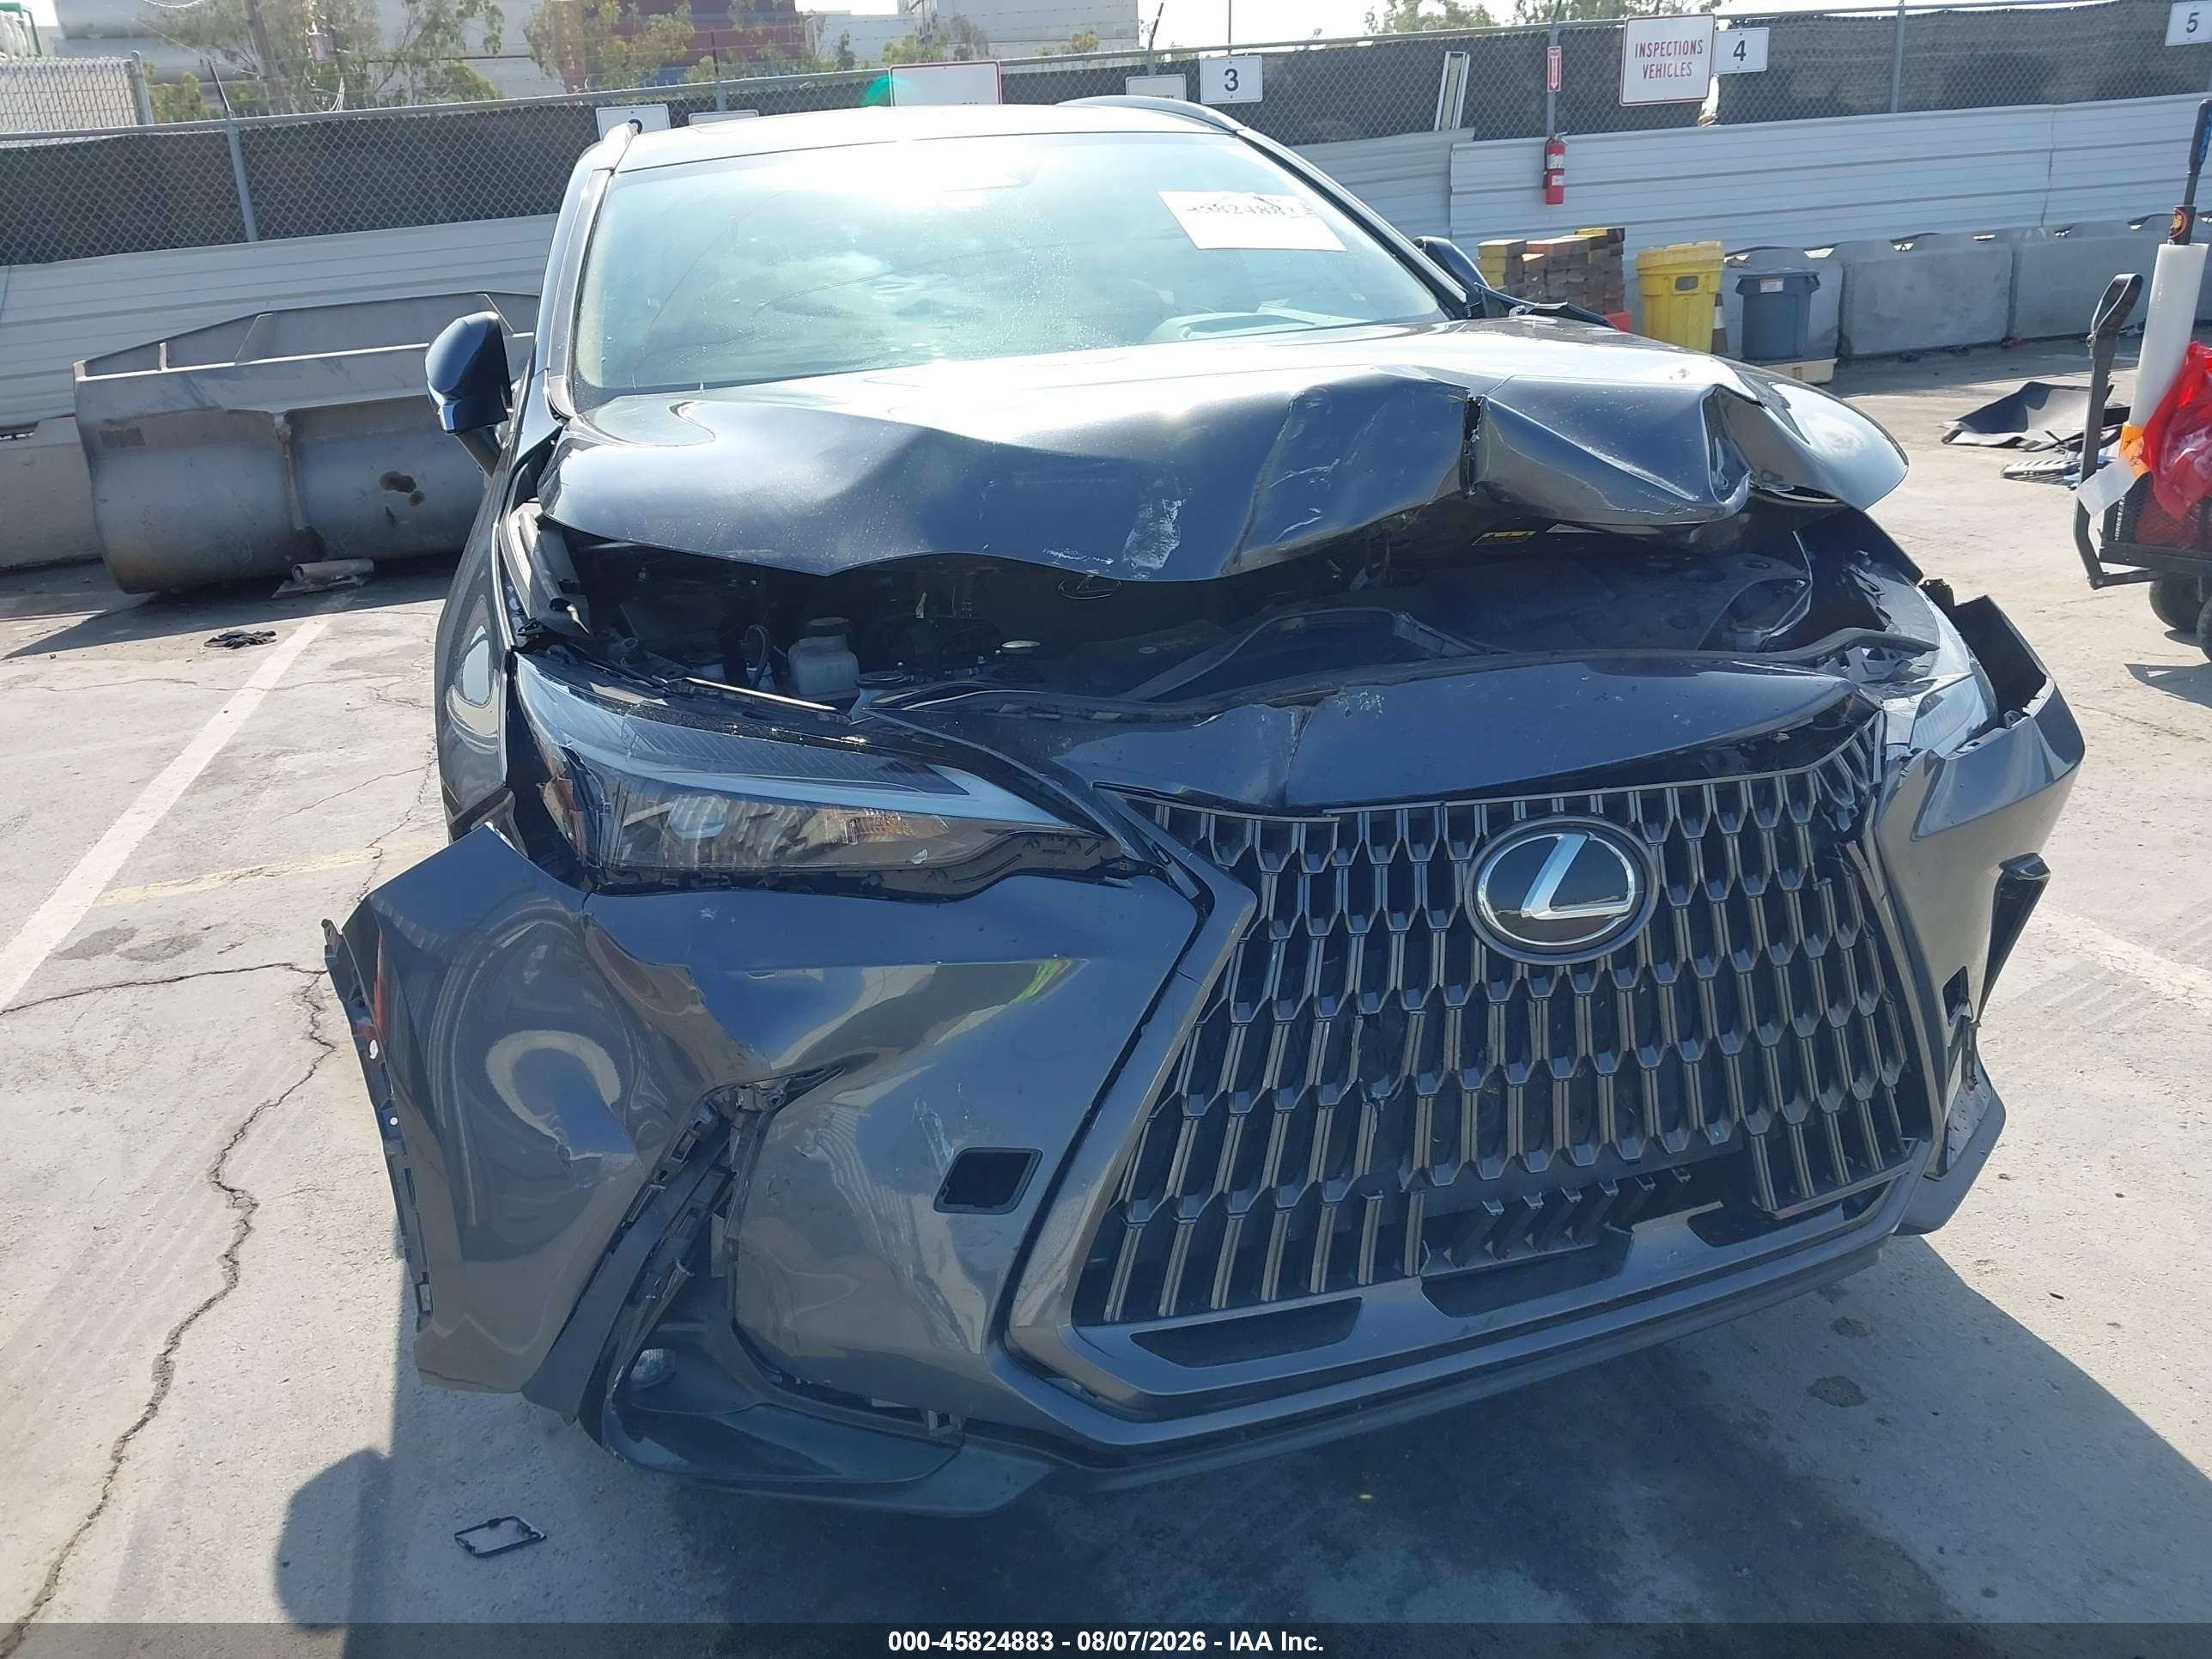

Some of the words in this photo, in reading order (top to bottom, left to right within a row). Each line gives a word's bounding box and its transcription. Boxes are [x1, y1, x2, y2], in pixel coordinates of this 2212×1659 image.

[2186, 12, 2199, 33] 5
[1635, 40, 1704, 58] INSPECTIONS
[1733, 40, 1747, 62] 4
[1224, 68, 1239, 92] 3
[1643, 62, 1692, 79] VEHICLES
